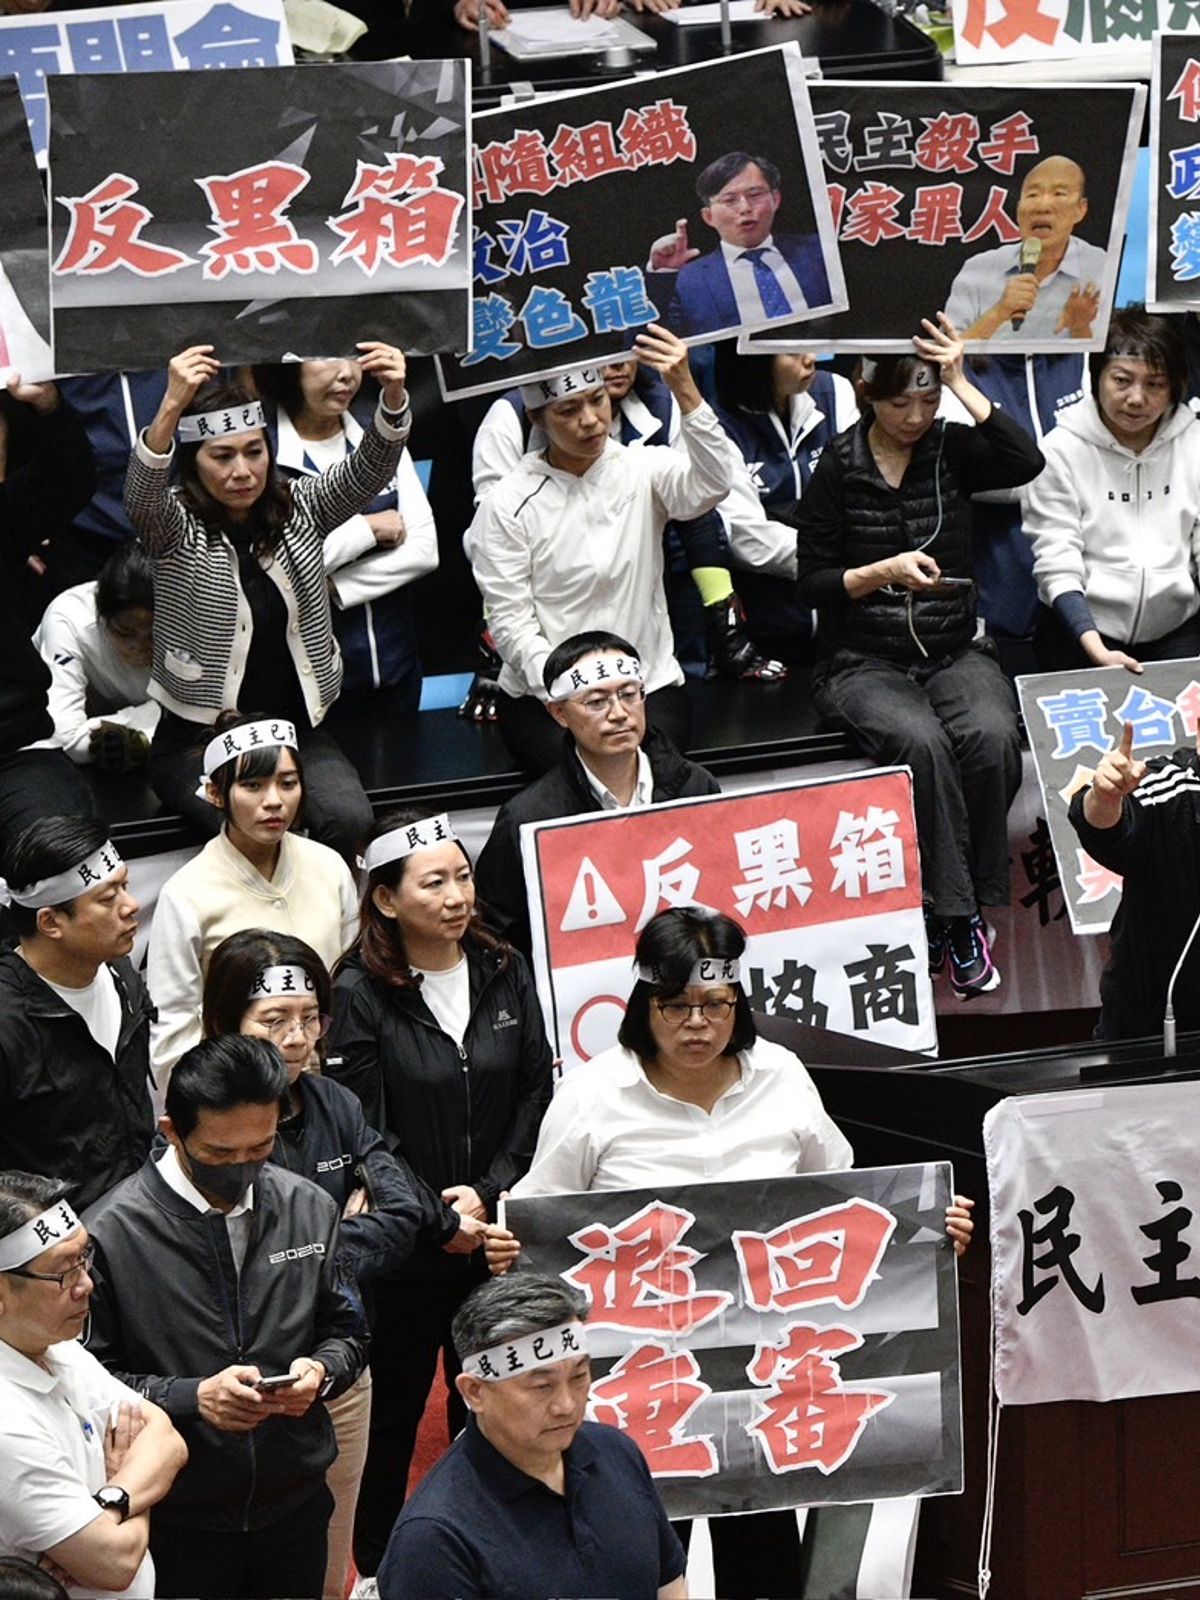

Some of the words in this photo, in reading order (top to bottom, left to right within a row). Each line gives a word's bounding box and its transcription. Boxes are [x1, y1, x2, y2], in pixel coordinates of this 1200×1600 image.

[813, 110, 1040, 175] 民主殺手
[54, 152, 465, 281] 反黑箱
[827, 181, 1022, 246] 家罪人
[460, 265, 661, 367] 變色龍
[406, 820, 456, 850] 民主
[634, 805, 908, 935] 反黑箱
[269, 1243, 325, 1264] 2020
[560, 1198, 897, 1336] 退回
[478, 1327, 580, 1378] 民主已死
[587, 1321, 896, 1476] 重審
